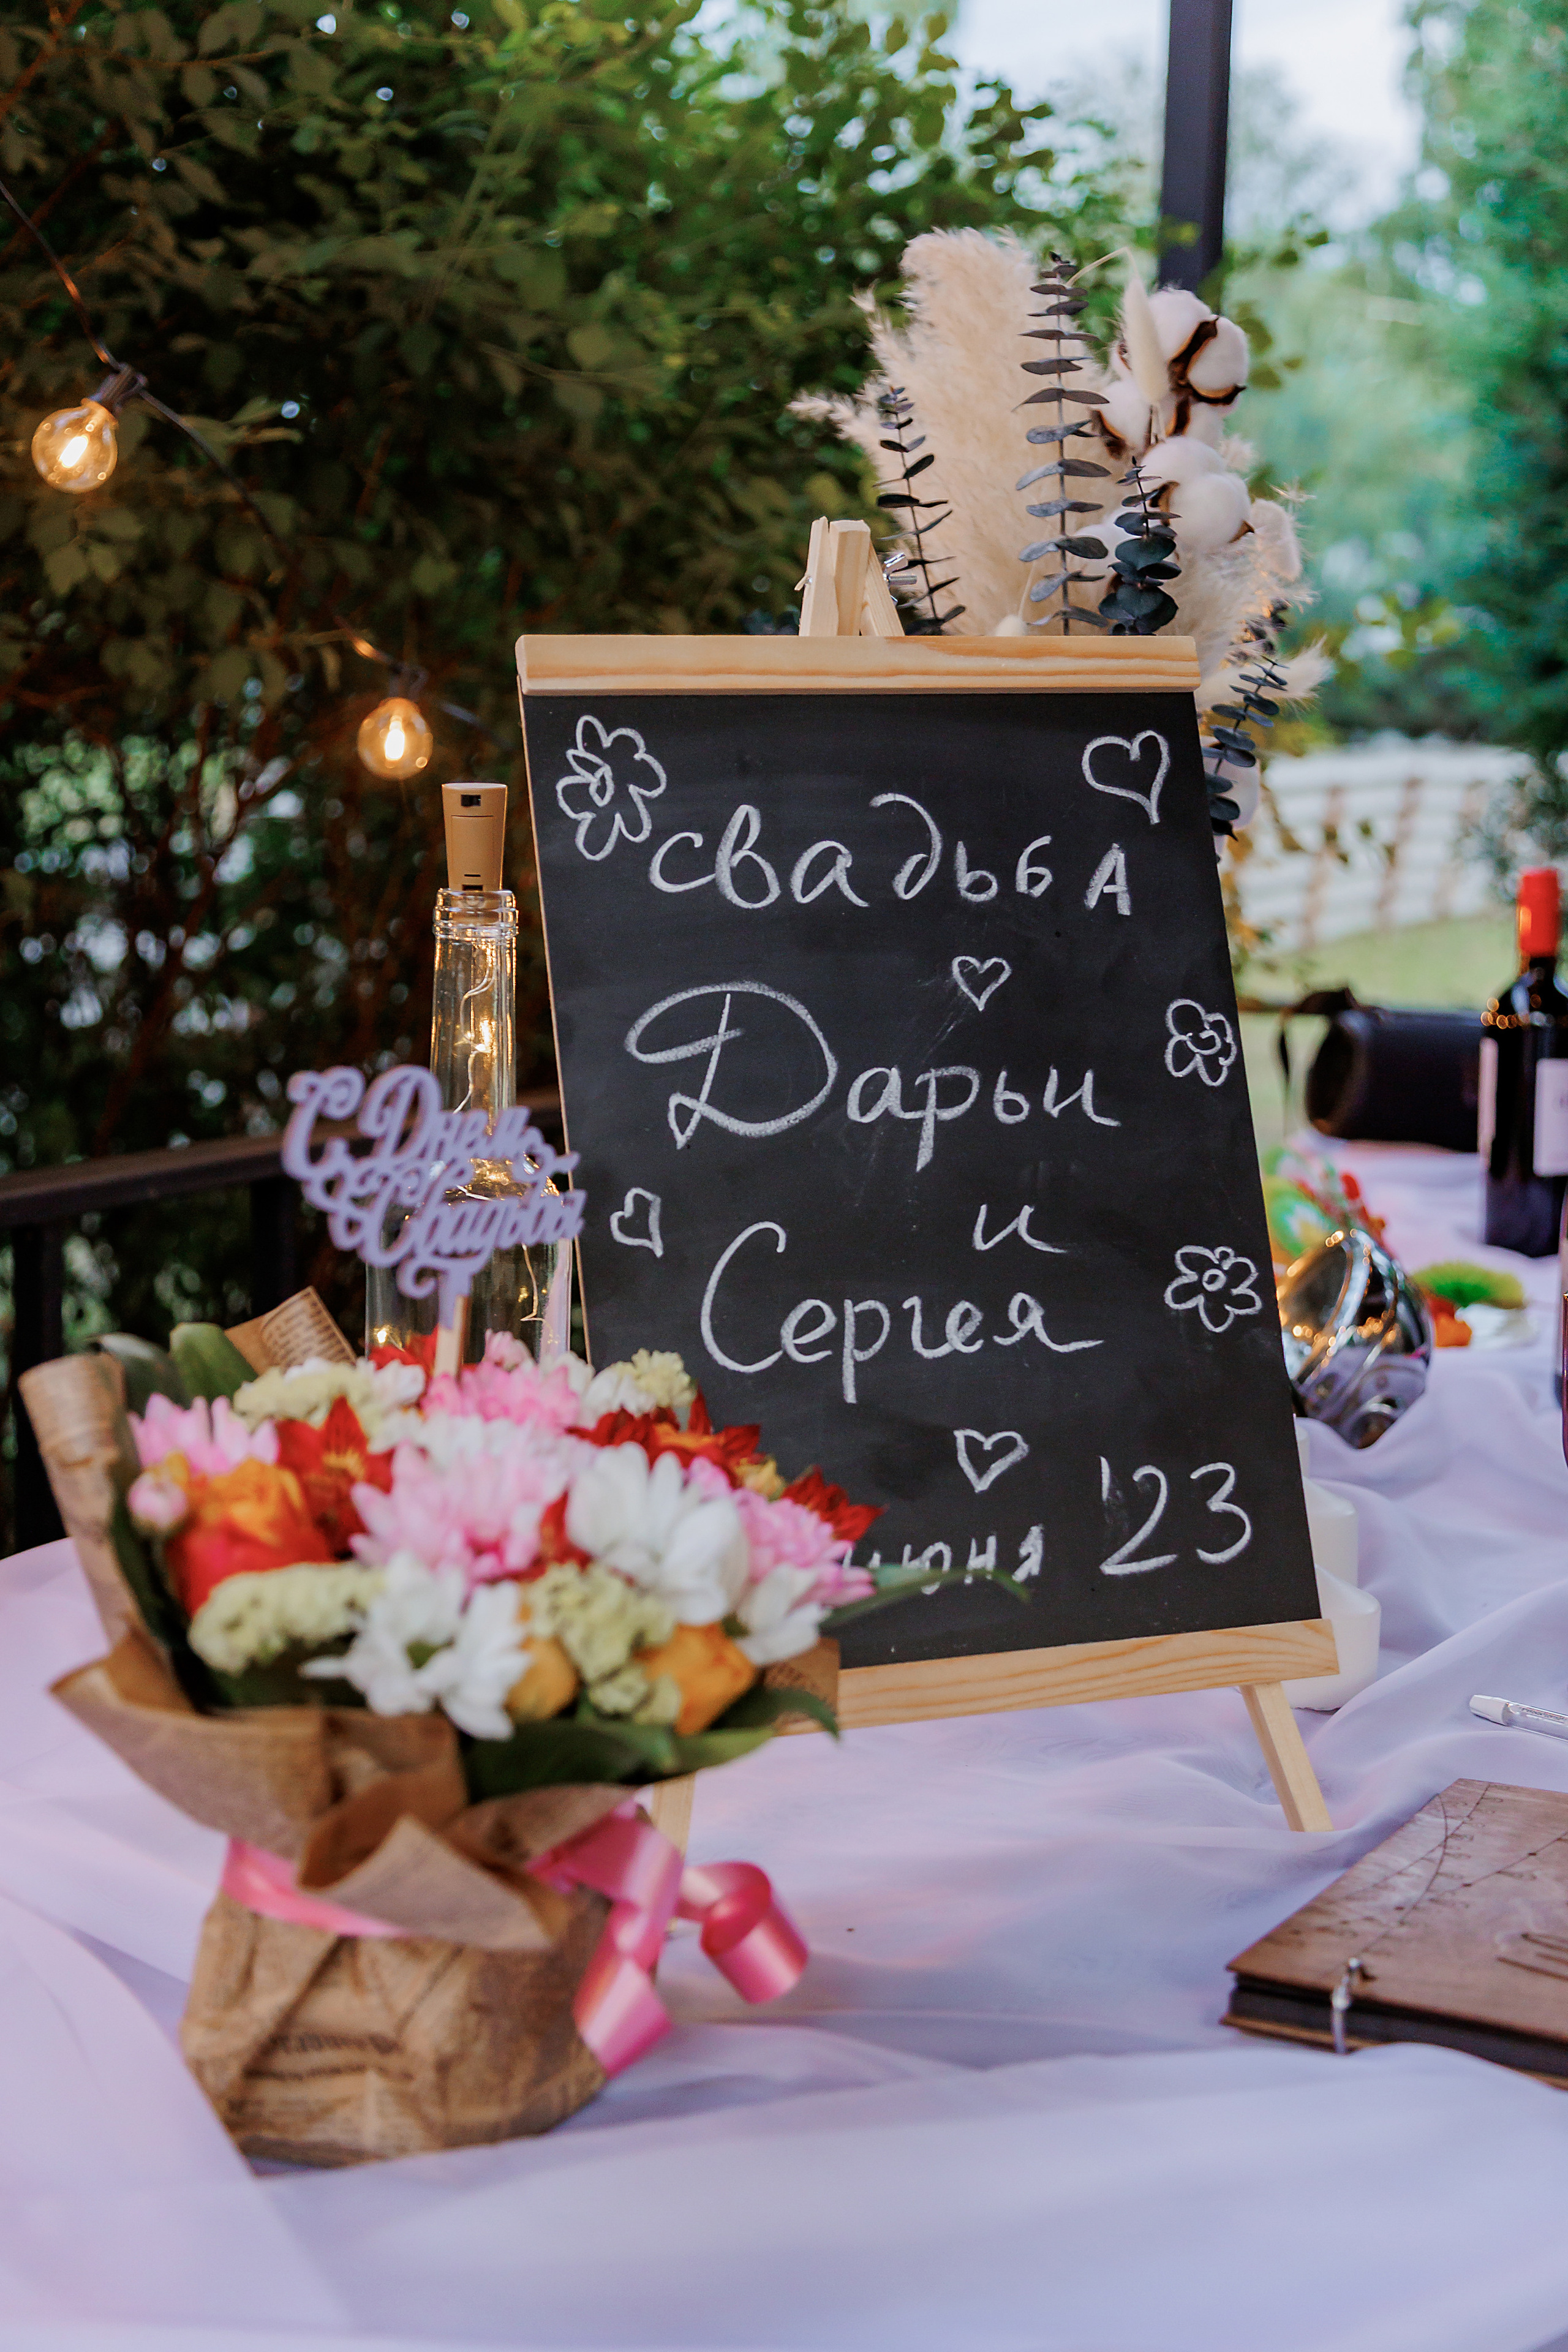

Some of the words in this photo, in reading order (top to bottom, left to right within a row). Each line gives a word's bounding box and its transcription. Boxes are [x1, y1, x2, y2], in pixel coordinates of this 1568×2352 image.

[625, 981, 1122, 1172] Дарьи
[700, 1221, 1104, 1404] Сергея
[973, 1204, 1067, 1254] и
